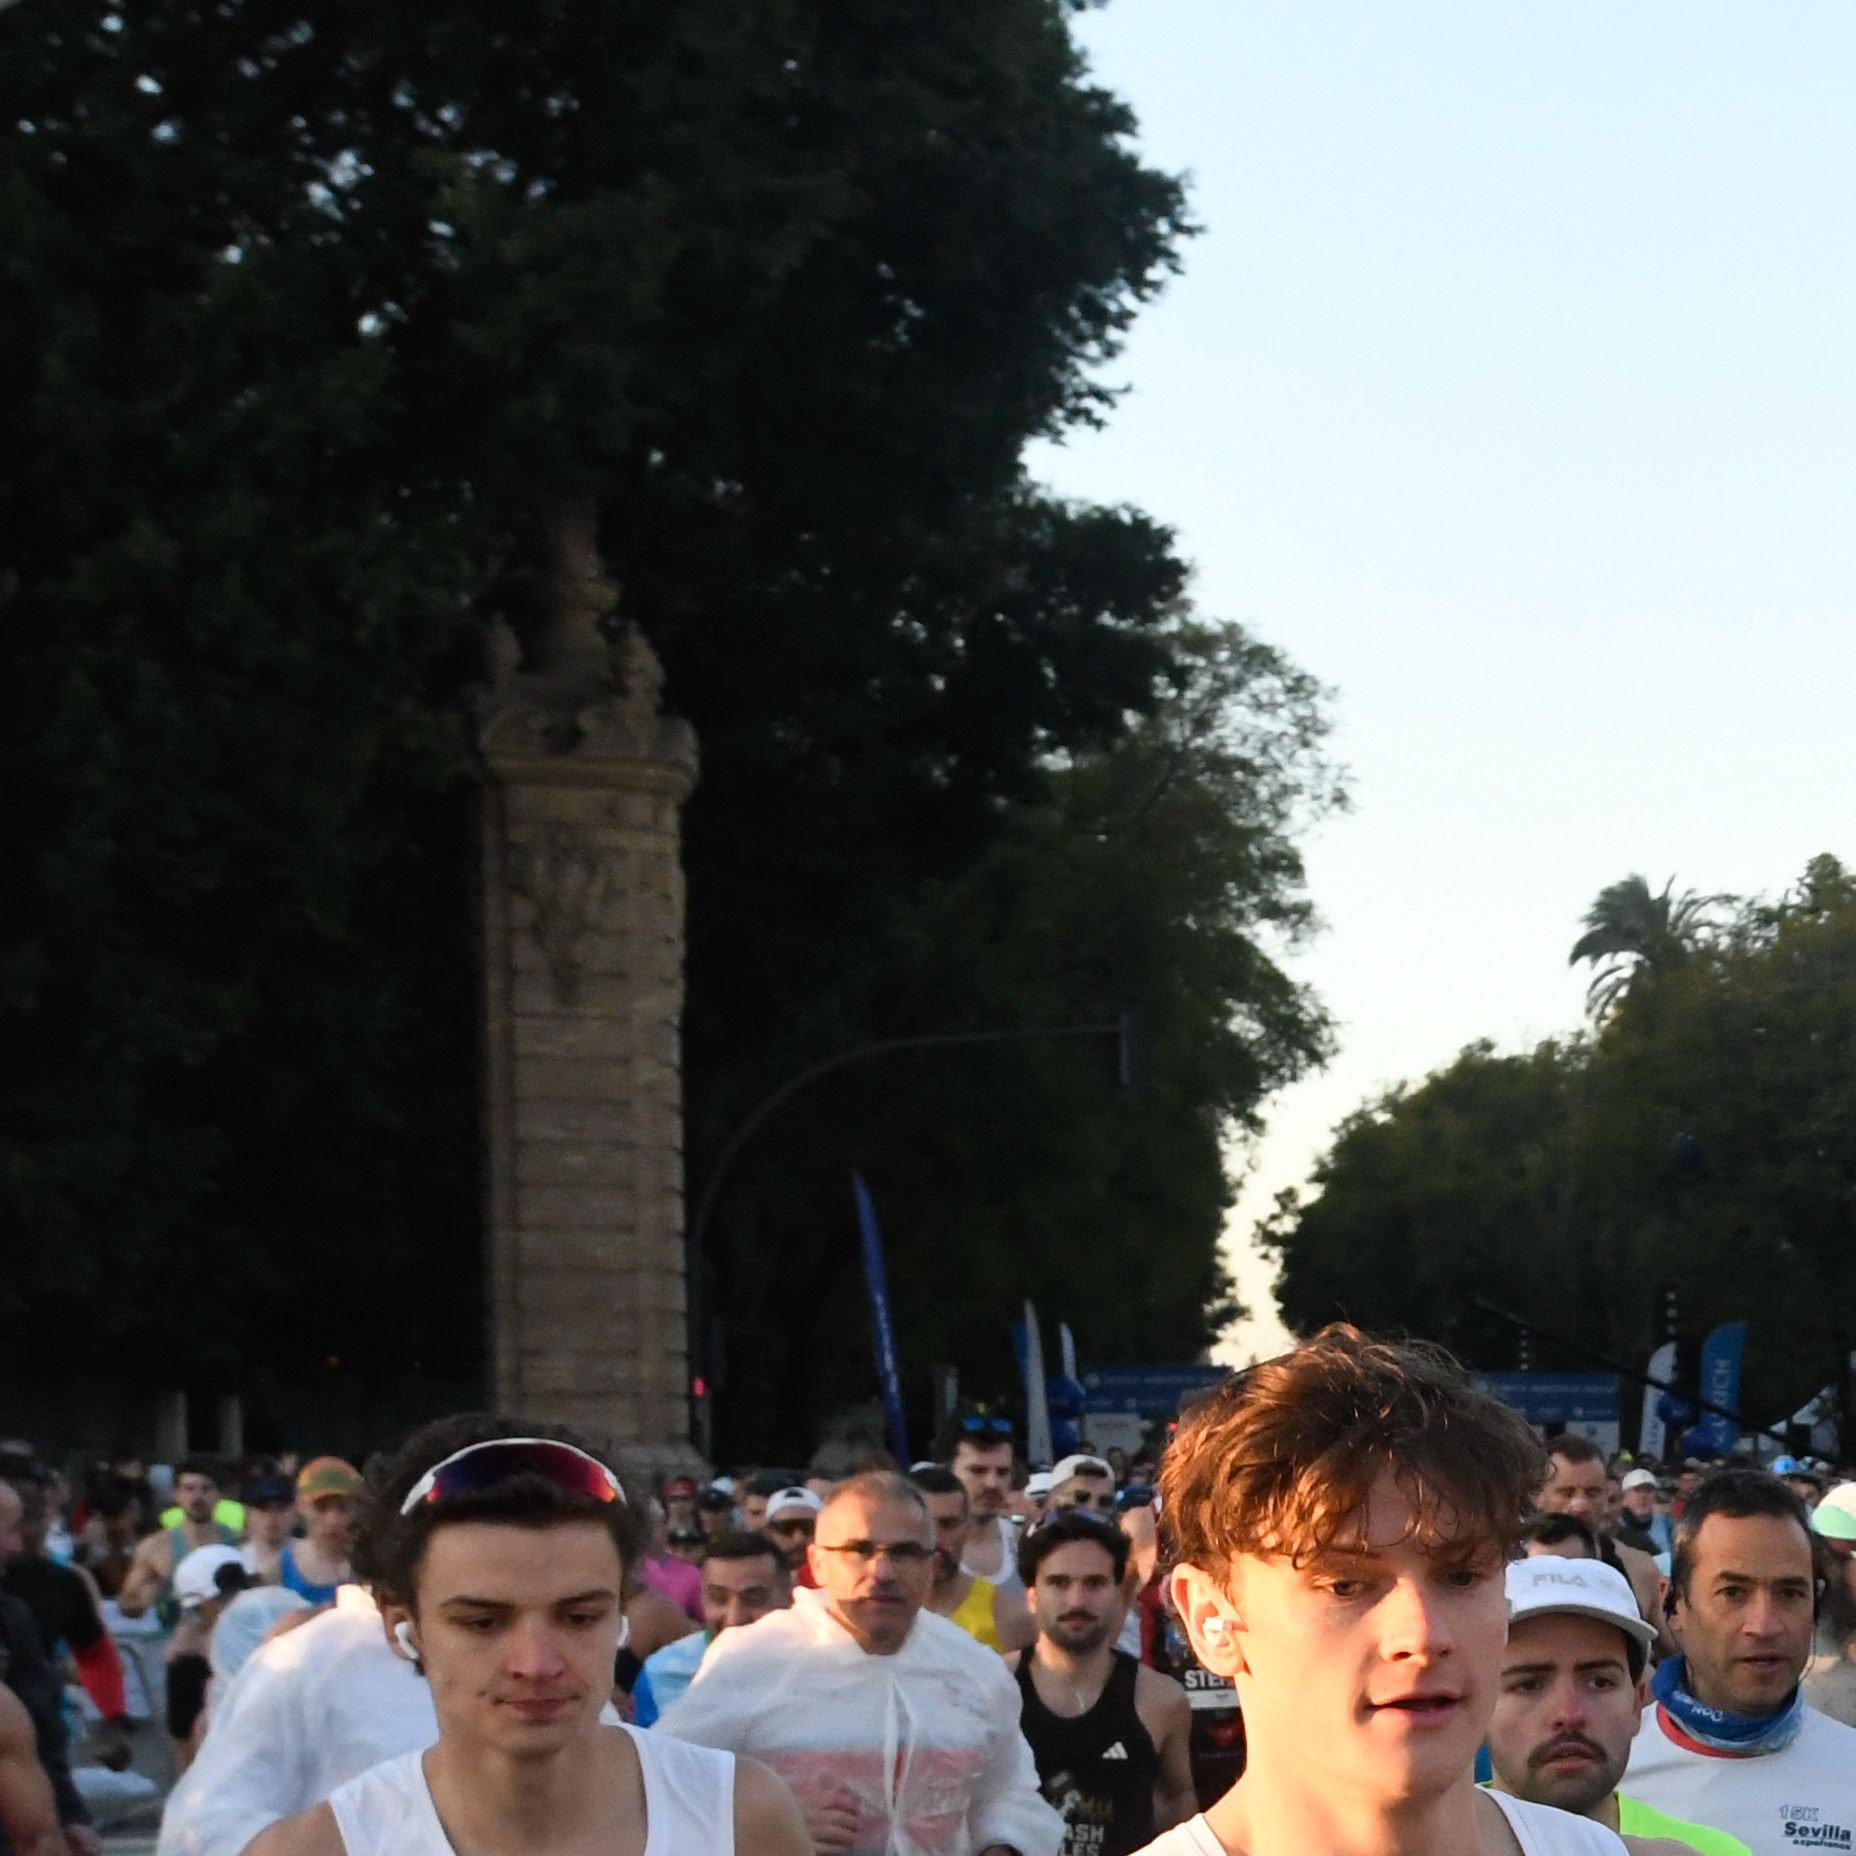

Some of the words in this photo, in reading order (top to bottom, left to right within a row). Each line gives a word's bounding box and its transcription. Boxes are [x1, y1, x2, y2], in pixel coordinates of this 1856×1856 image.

[1532, 1573, 1588, 1589] FILA
[1784, 1821, 1851, 1841] Sevilla
[1793, 1839, 1852, 1851] experience
